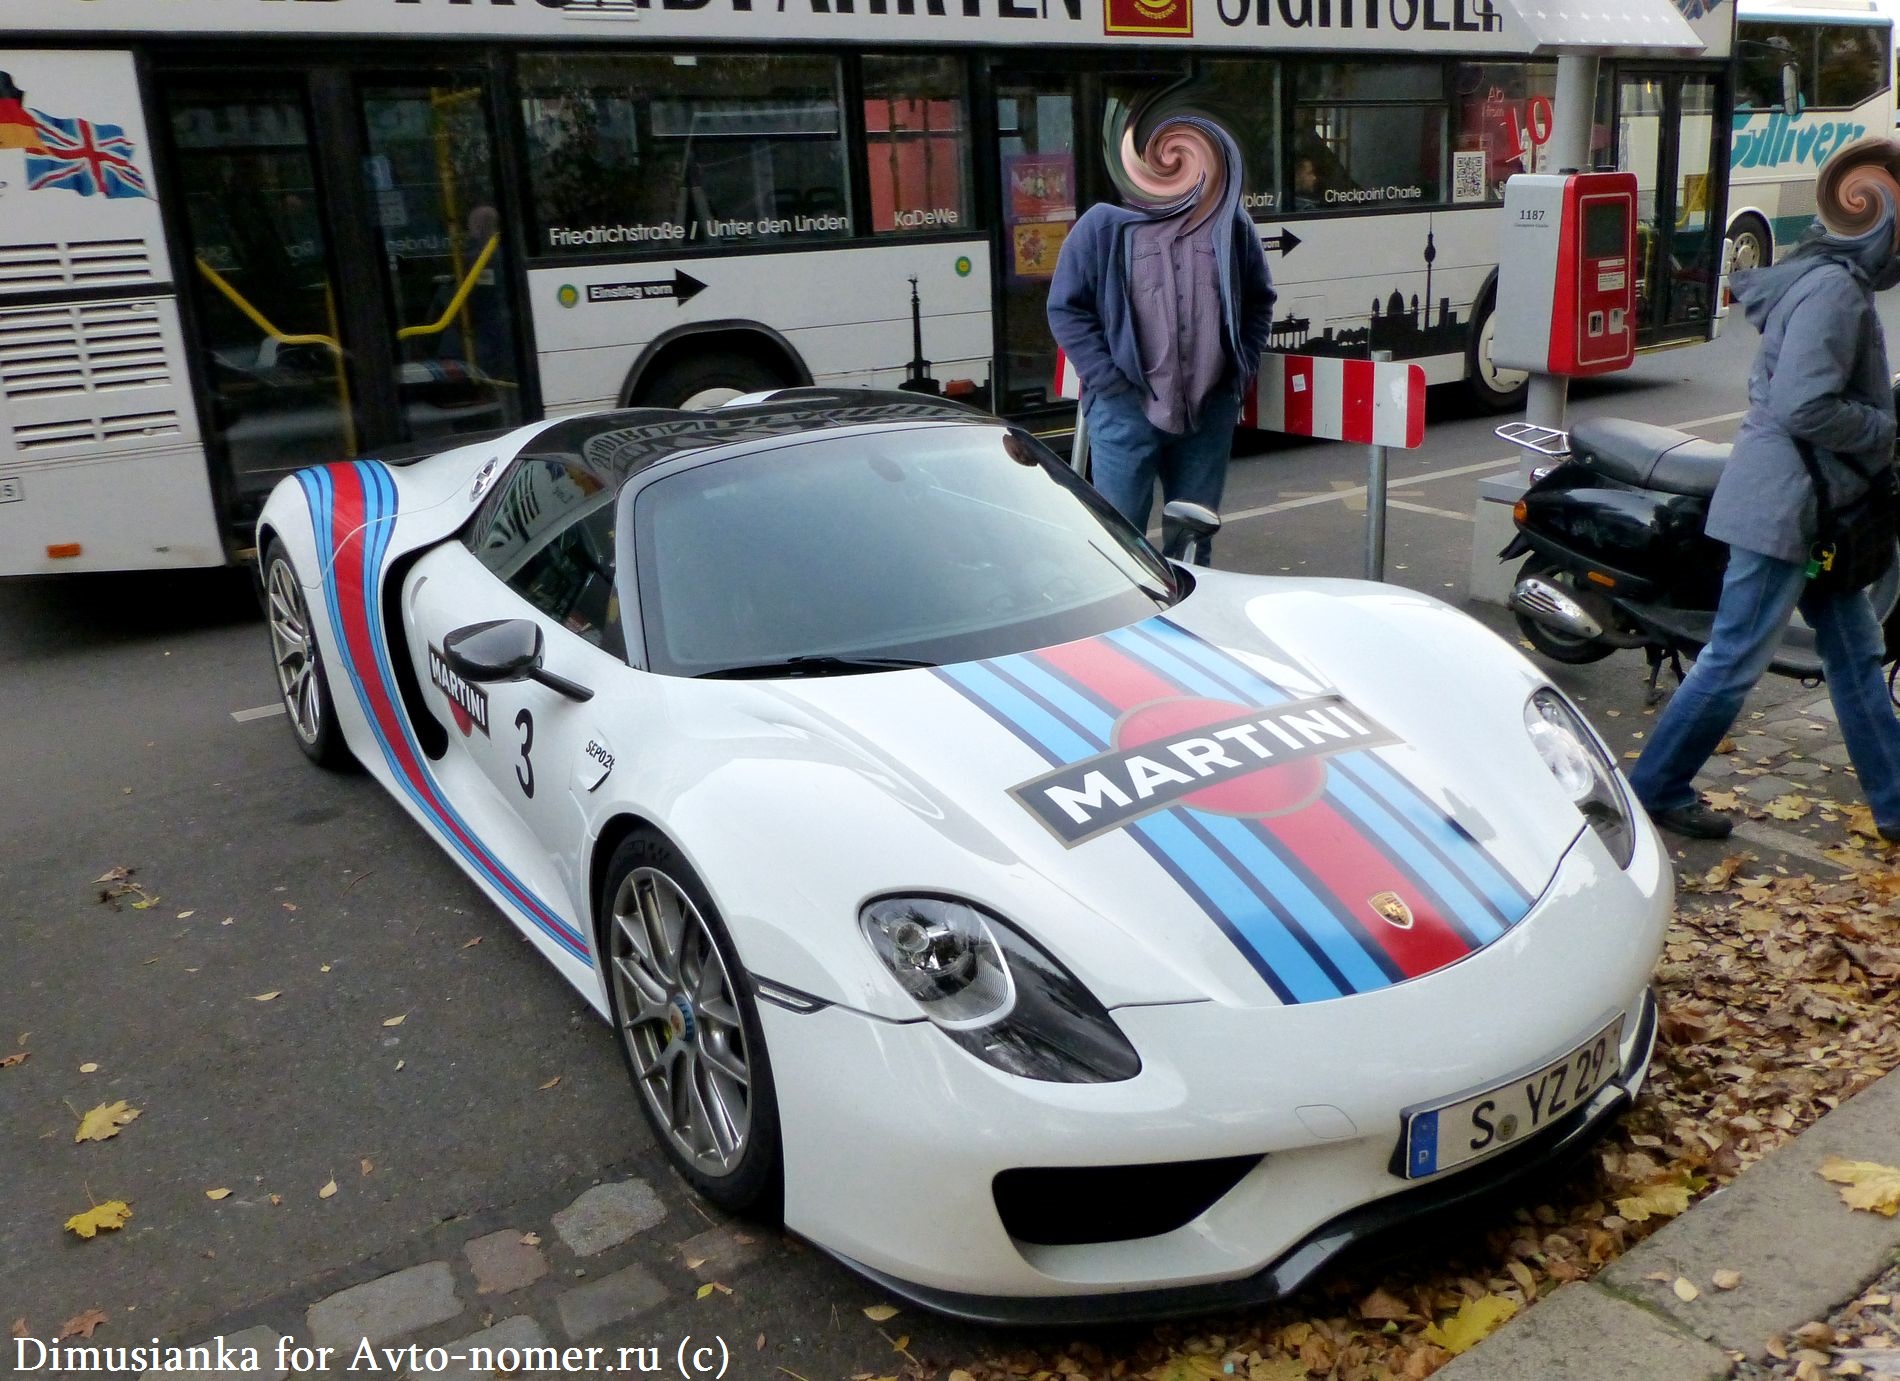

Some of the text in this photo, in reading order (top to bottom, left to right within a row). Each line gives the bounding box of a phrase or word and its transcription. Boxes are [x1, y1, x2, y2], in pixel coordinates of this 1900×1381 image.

[1500, 96, 1553, 163] 10
[1325, 184, 1422, 204] Checkpoint Charlie
[550, 222, 686, 247] Friedrichstraße
[707, 219, 755, 238] Unter
[757, 217, 791, 234] den
[794, 213, 851, 233] Linden
[894, 208, 958, 227] KaDeWe
[1519, 210, 1545, 221] 1187
[590, 284, 643, 300] Einstieg
[430, 652, 487, 727] MARTINI
[514, 708, 535, 799] 3
[1043, 706, 1371, 825] MARTINI
[1470, 1100, 1496, 1150] S
